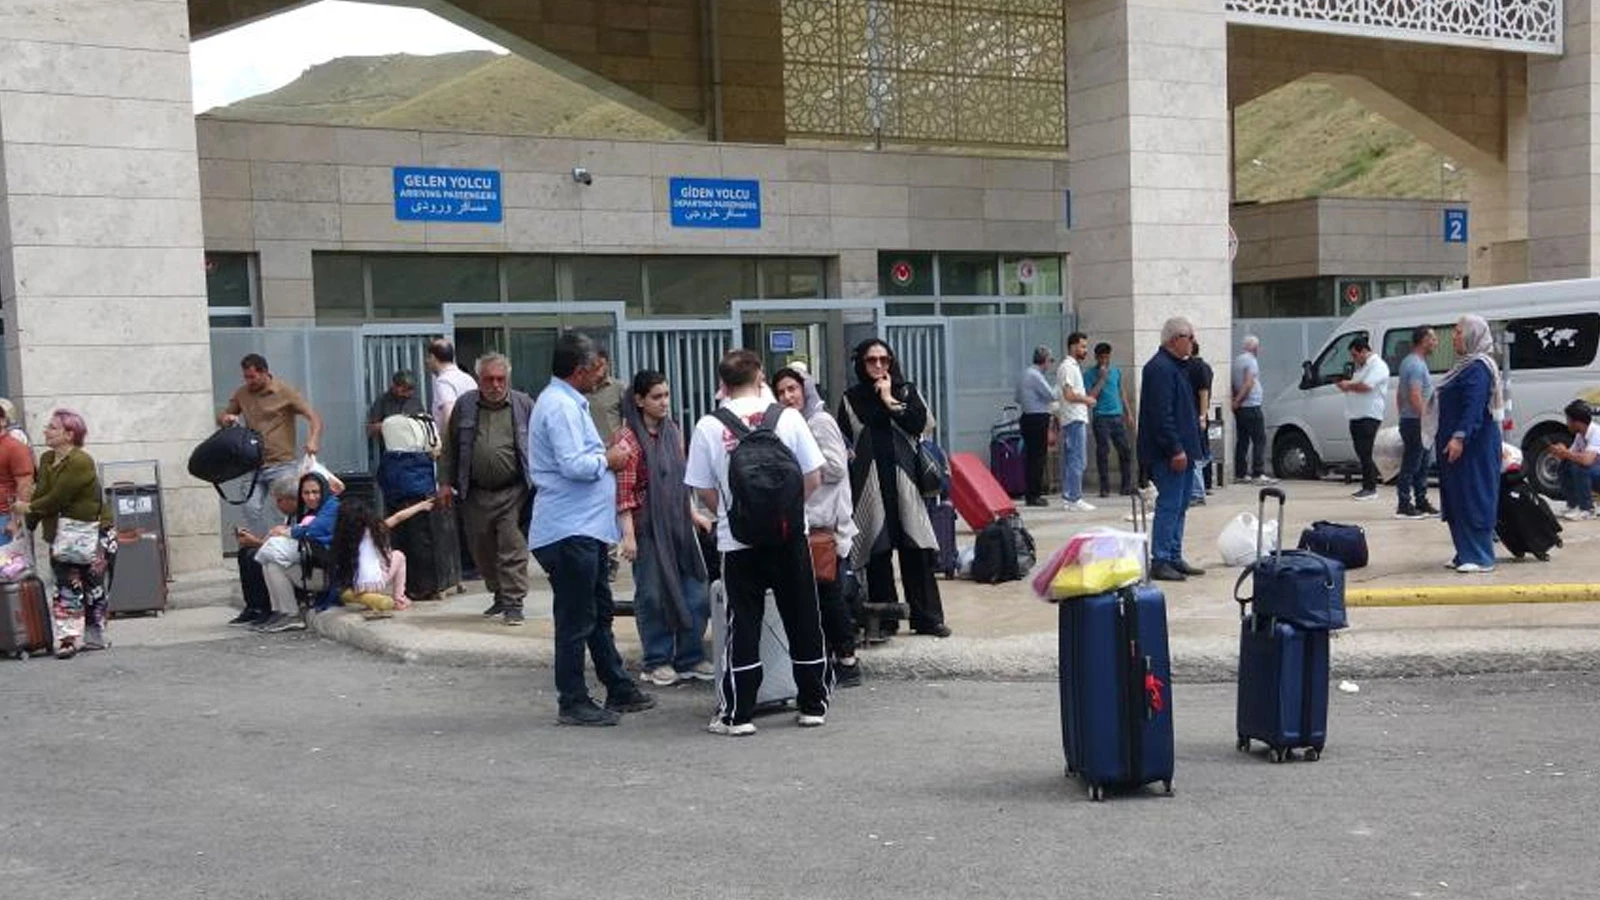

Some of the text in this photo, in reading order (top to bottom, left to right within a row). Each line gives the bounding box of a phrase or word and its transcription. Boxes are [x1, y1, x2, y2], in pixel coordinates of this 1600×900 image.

[403, 175, 492, 189] GELEN YOLCU
[400, 189, 497, 200] ARRIVING PASSENGERS
[681, 185, 750, 200] GİDEN YOLCU
[1450, 220, 1462, 240] 2
